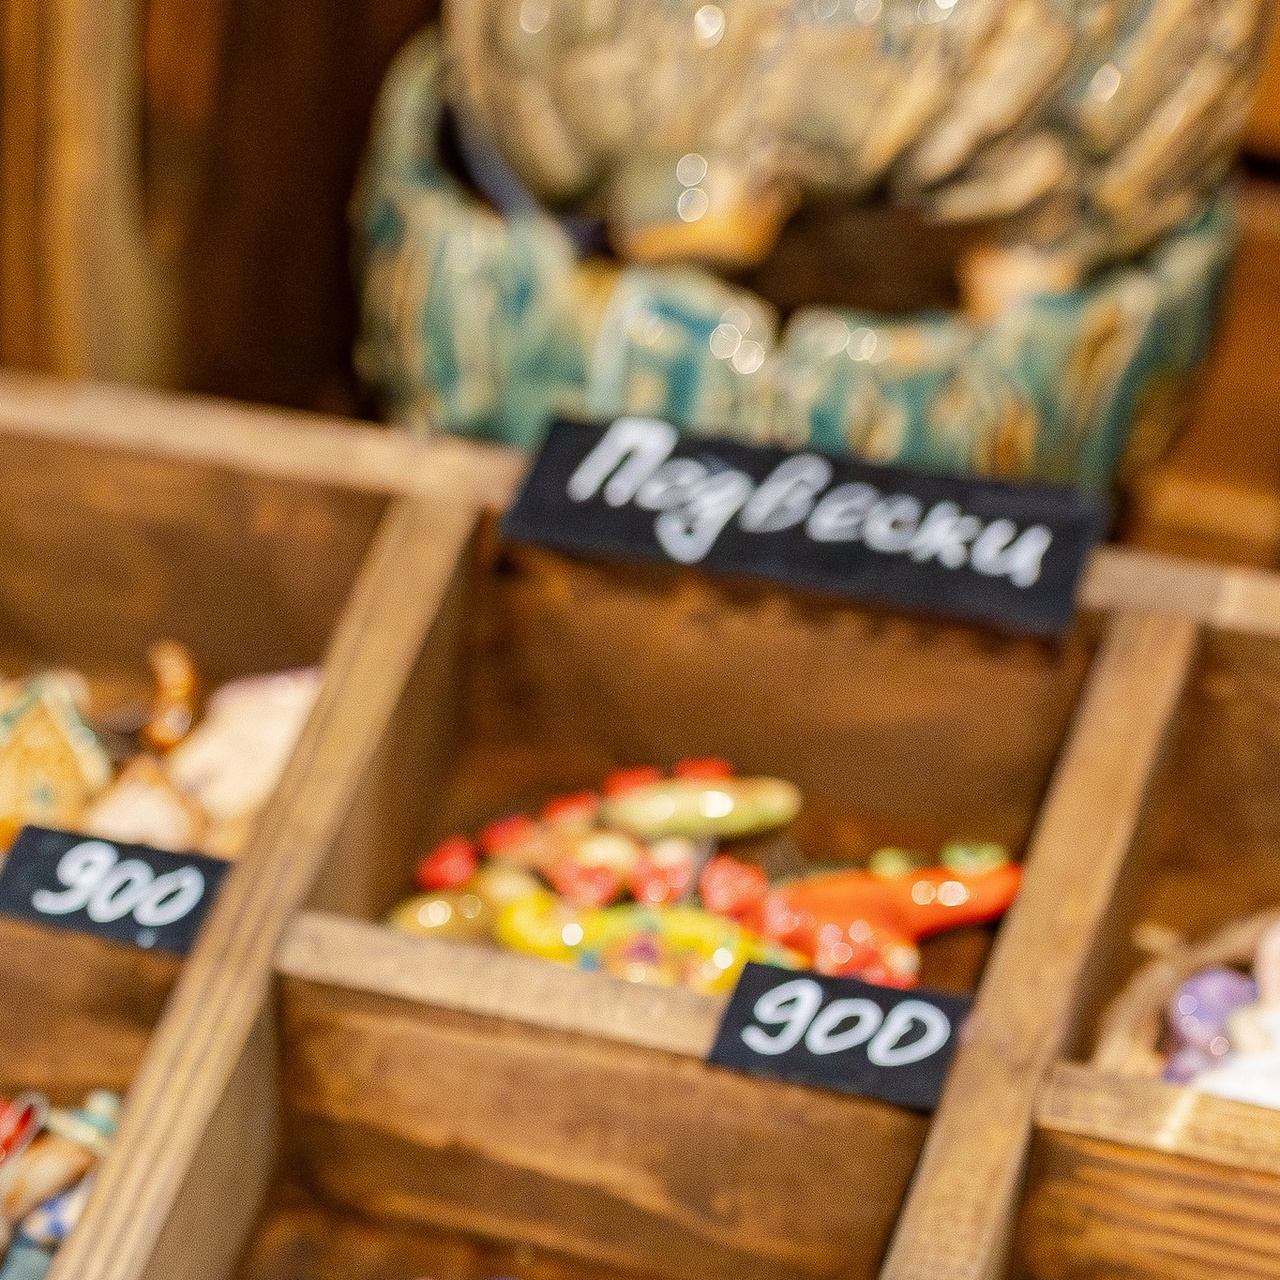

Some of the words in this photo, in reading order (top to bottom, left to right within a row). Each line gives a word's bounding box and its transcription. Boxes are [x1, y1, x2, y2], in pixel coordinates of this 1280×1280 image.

[567, 416, 1051, 588] Подвески
[31, 840, 205, 926] 900
[740, 978, 951, 1067] 900
